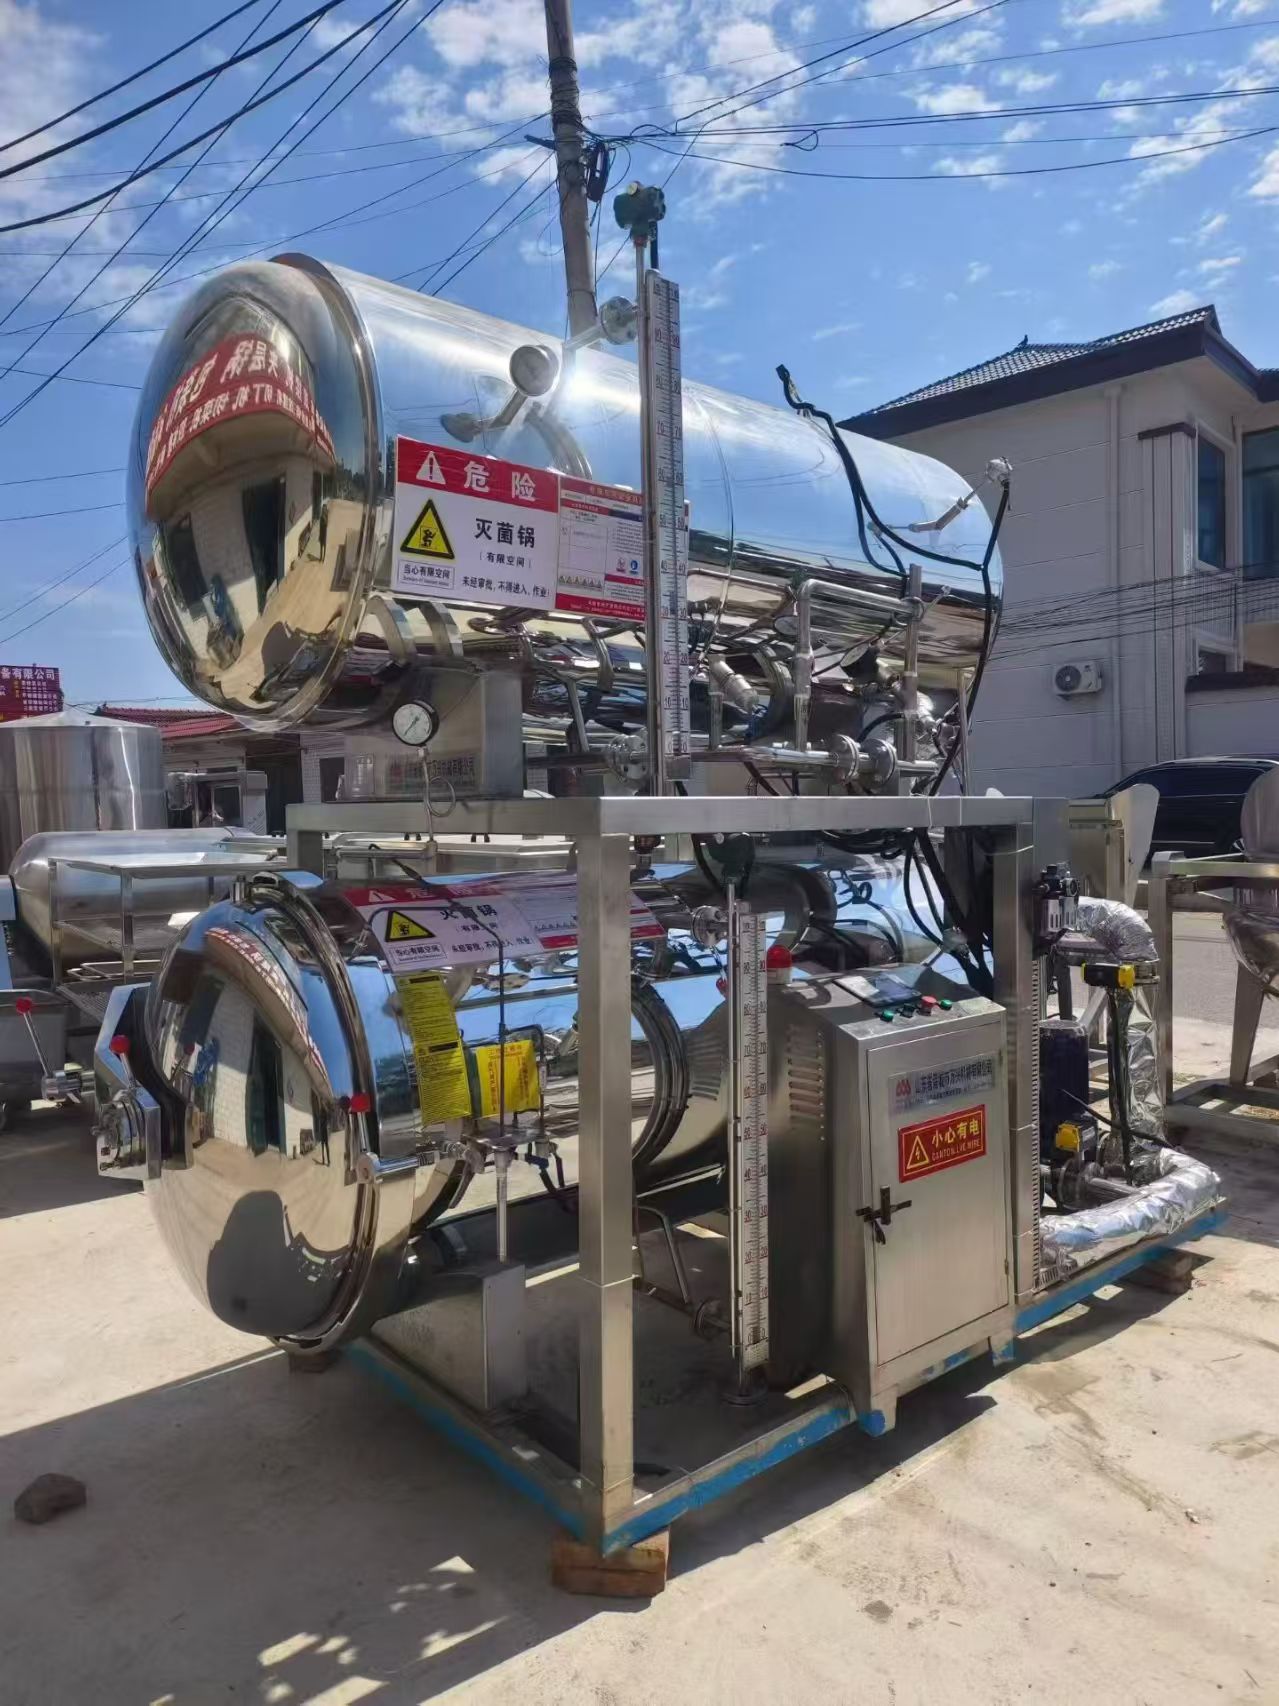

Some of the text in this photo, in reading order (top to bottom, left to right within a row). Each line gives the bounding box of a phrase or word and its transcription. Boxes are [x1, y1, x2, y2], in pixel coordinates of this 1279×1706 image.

[463, 461, 536, 502] 危险
[474, 517, 536, 549] 灭菌锅
[403, 563, 450, 580] 当心有限空间
[440, 904, 498, 920] 灭锅
[932, 1119, 980, 1148] 小心有电
